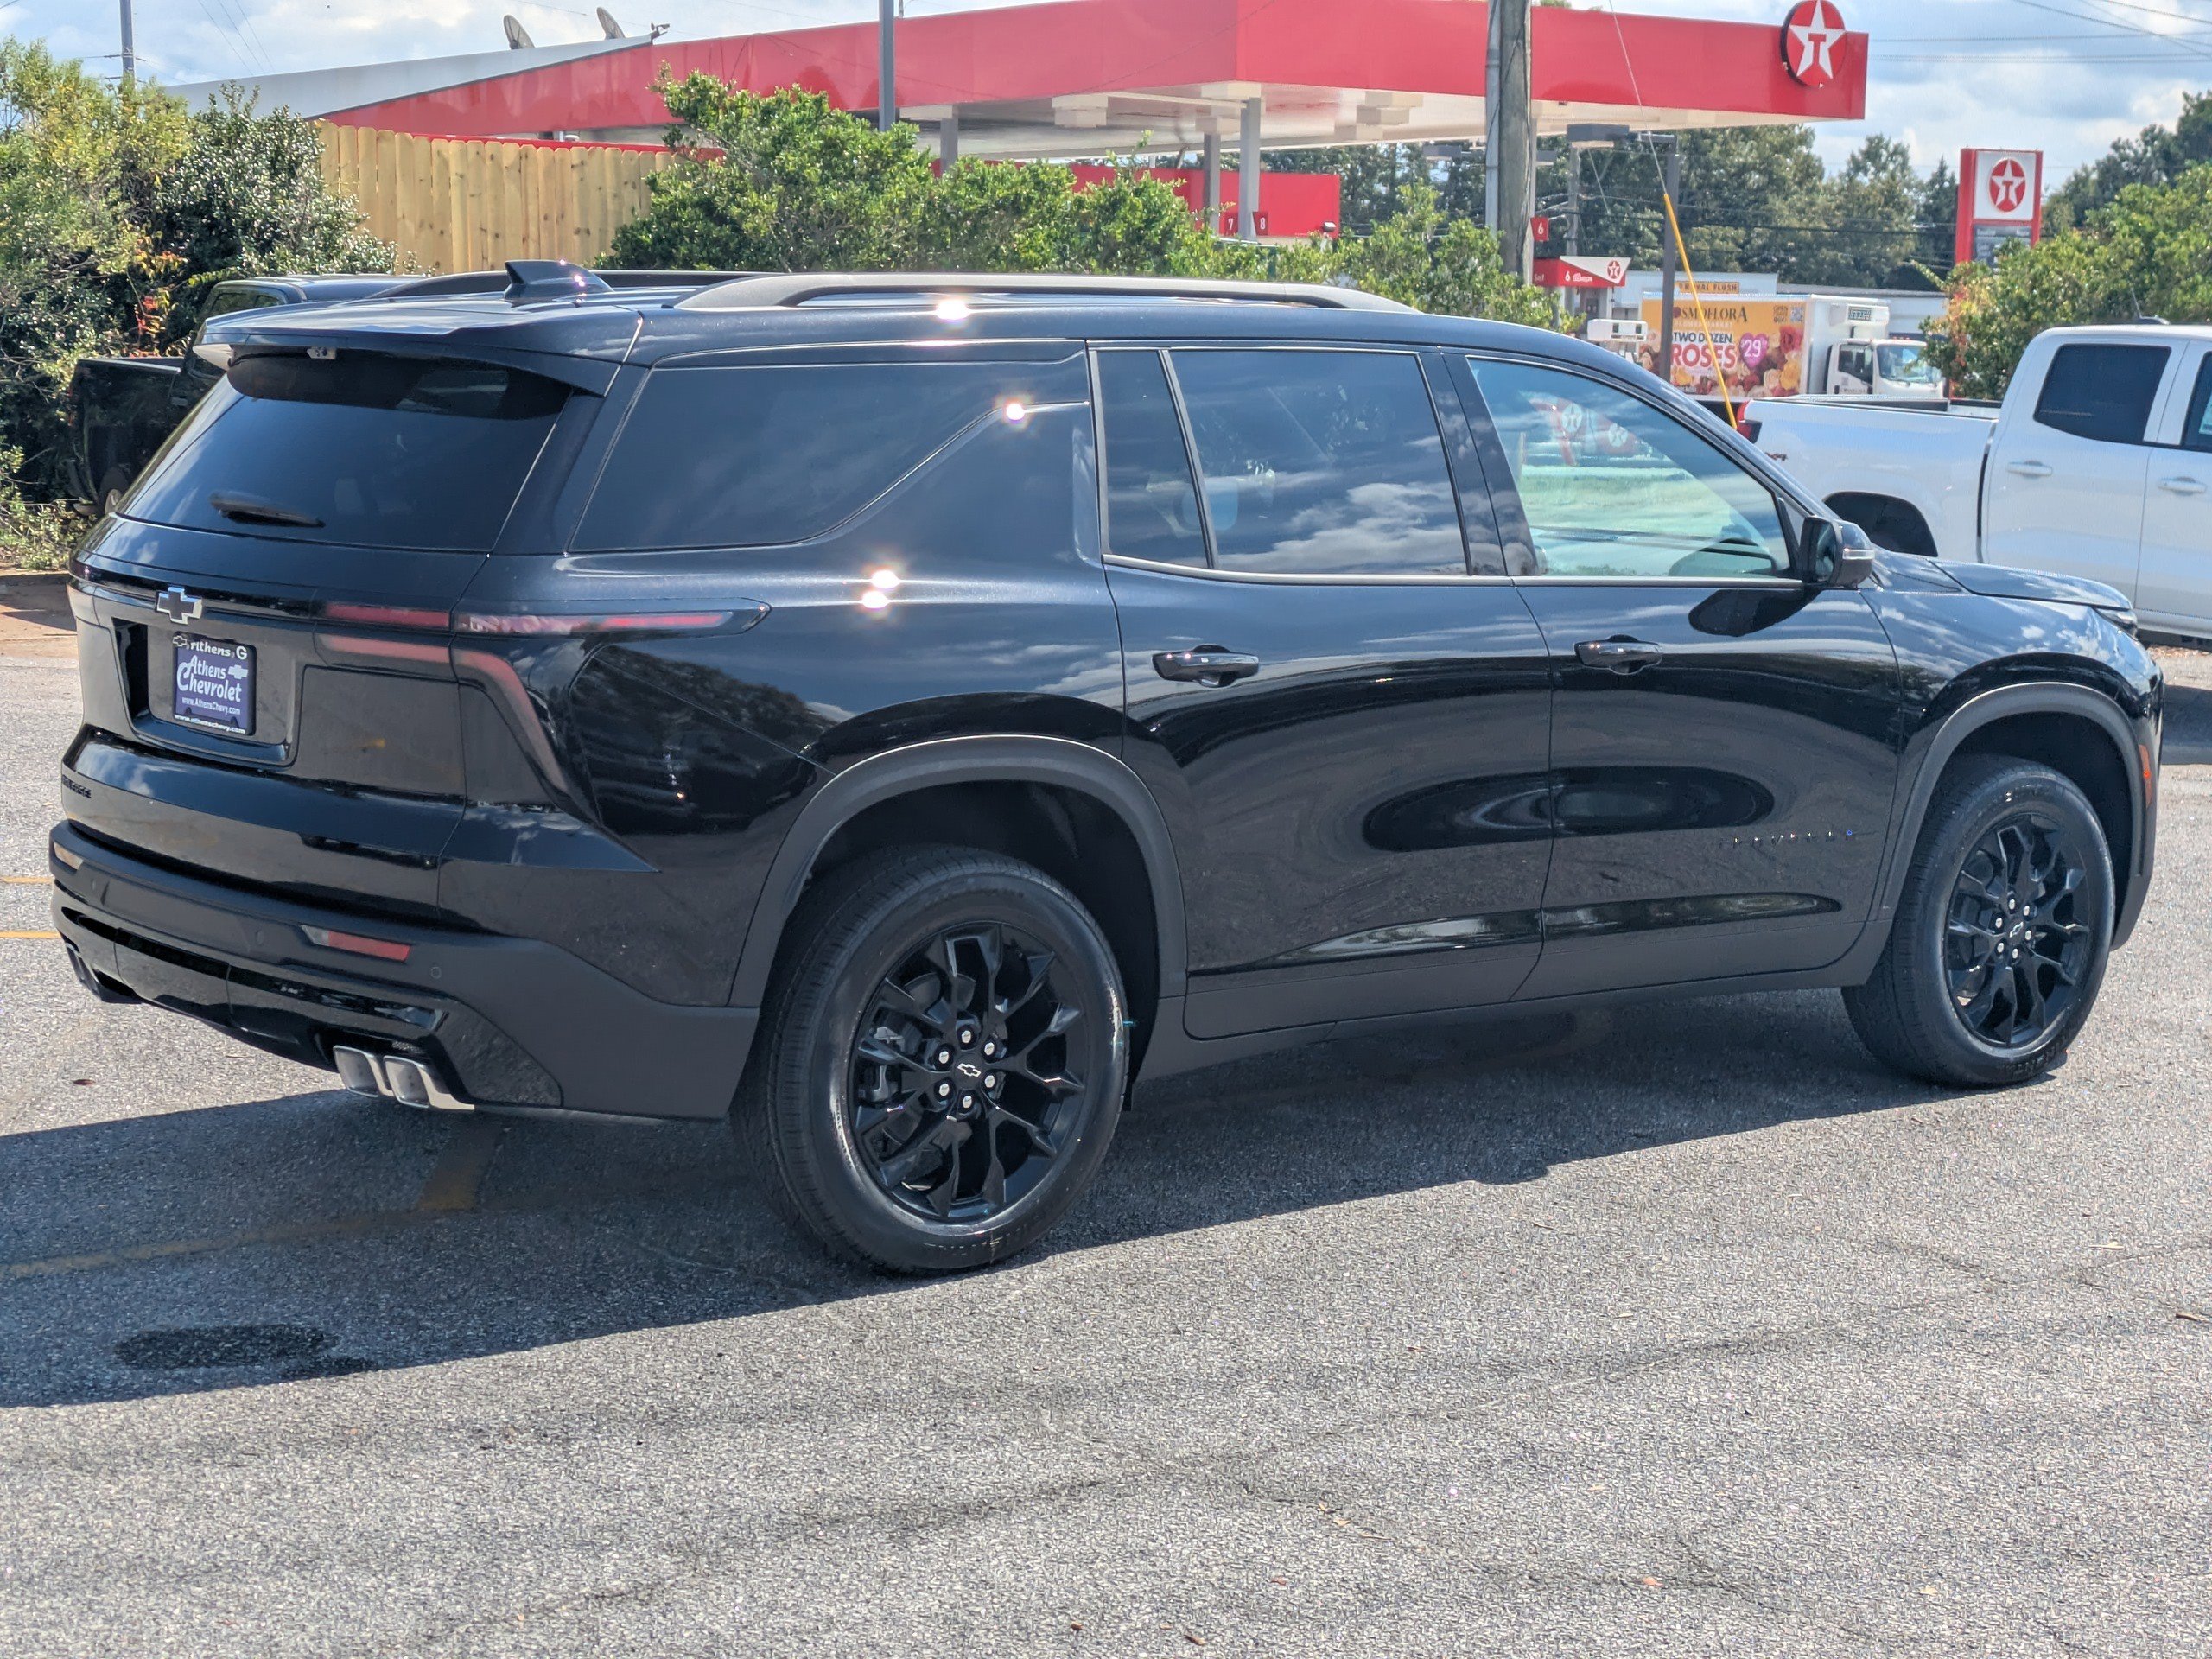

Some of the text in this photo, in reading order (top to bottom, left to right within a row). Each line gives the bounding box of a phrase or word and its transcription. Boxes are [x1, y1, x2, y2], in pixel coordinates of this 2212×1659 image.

[1228, 218, 1234, 231] 7
[1260, 217, 1266, 230] 8
[1538, 222, 1544, 235] 6
[1565, 270, 1571, 282] 6
[1674, 332, 1696, 343] TWO
[1671, 343, 1736, 369] ROSES
[183, 655, 226, 680] Athens
[176, 661, 242, 702] Chevrolet
